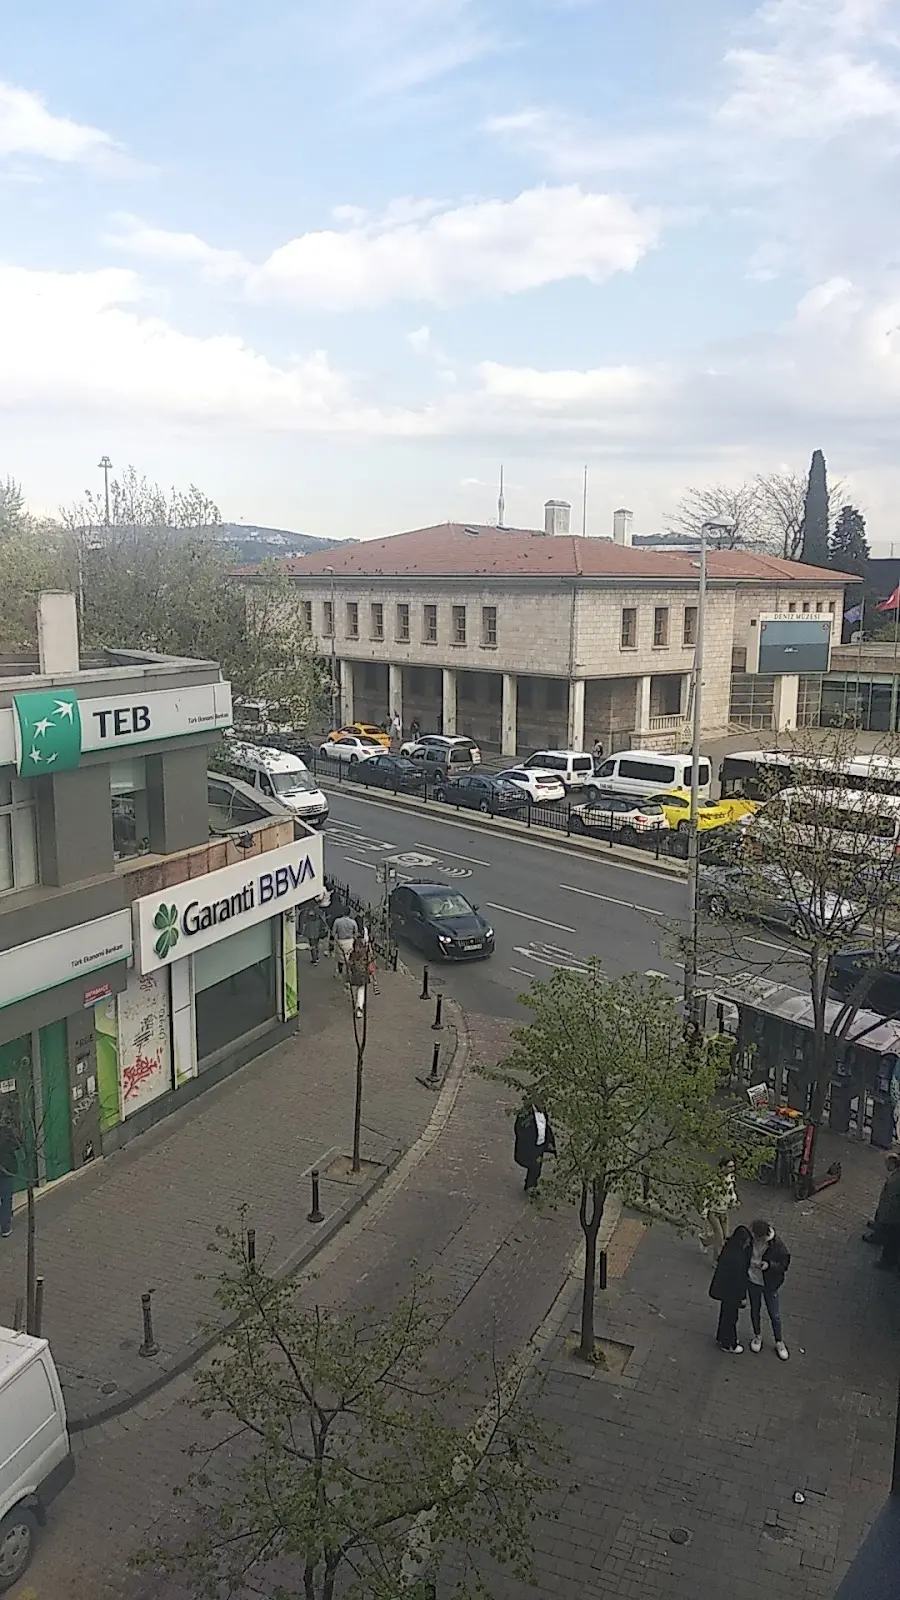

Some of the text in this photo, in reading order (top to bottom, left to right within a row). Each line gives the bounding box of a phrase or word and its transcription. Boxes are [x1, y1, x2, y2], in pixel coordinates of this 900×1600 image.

[92, 705, 151, 738] TEB
[182, 854, 316, 936] Garanti BBVA
[71, 958, 83, 968] Türk
[83, 949, 105, 963] Ekonomi
